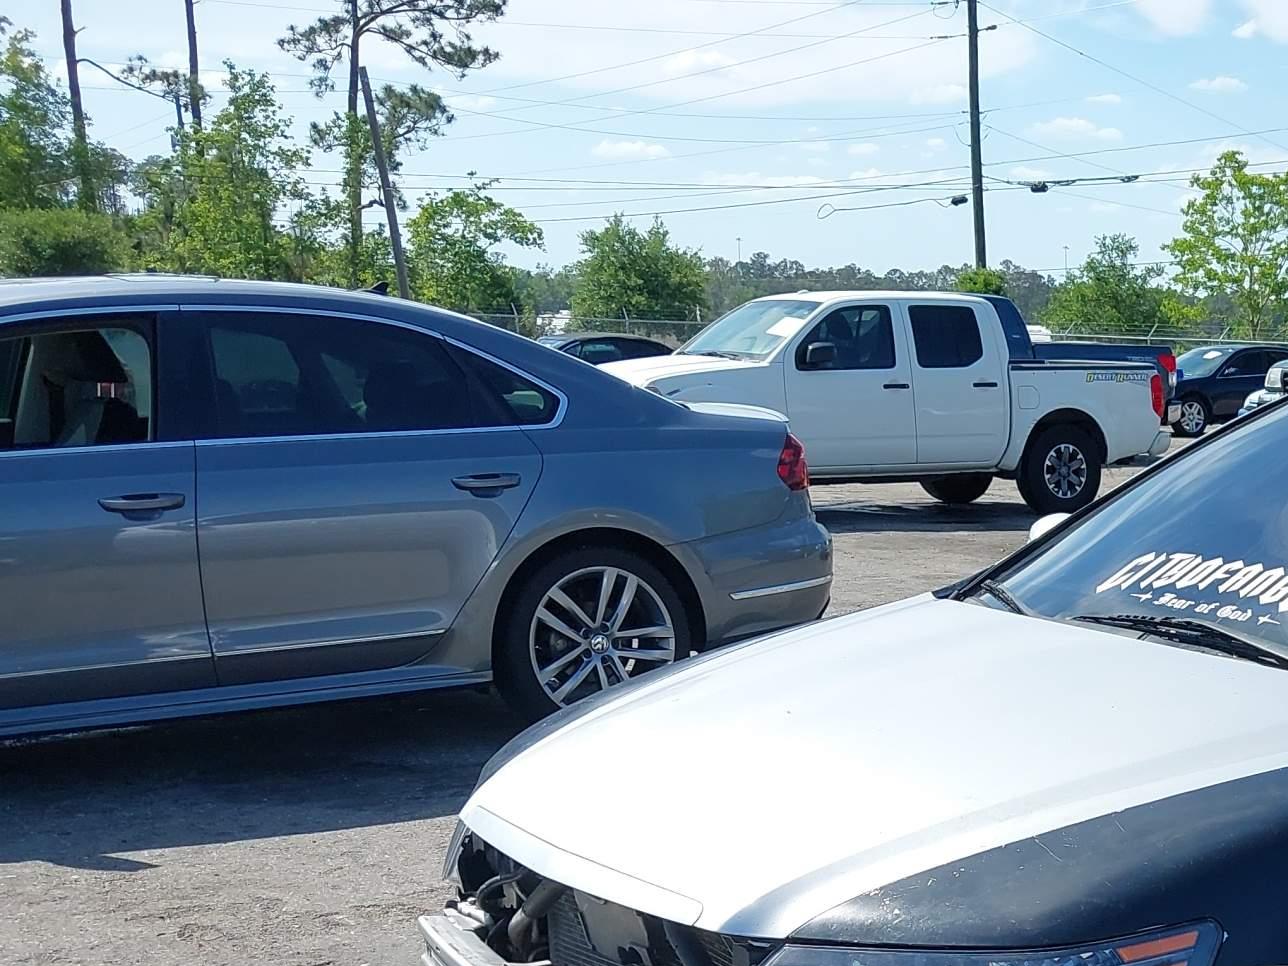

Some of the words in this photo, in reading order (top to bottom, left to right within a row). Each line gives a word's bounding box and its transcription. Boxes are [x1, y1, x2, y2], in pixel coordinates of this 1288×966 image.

[1152, 592, 1196, 610] Fear
[1194, 602, 1220, 614] of
[1216, 605, 1252, 622] God
